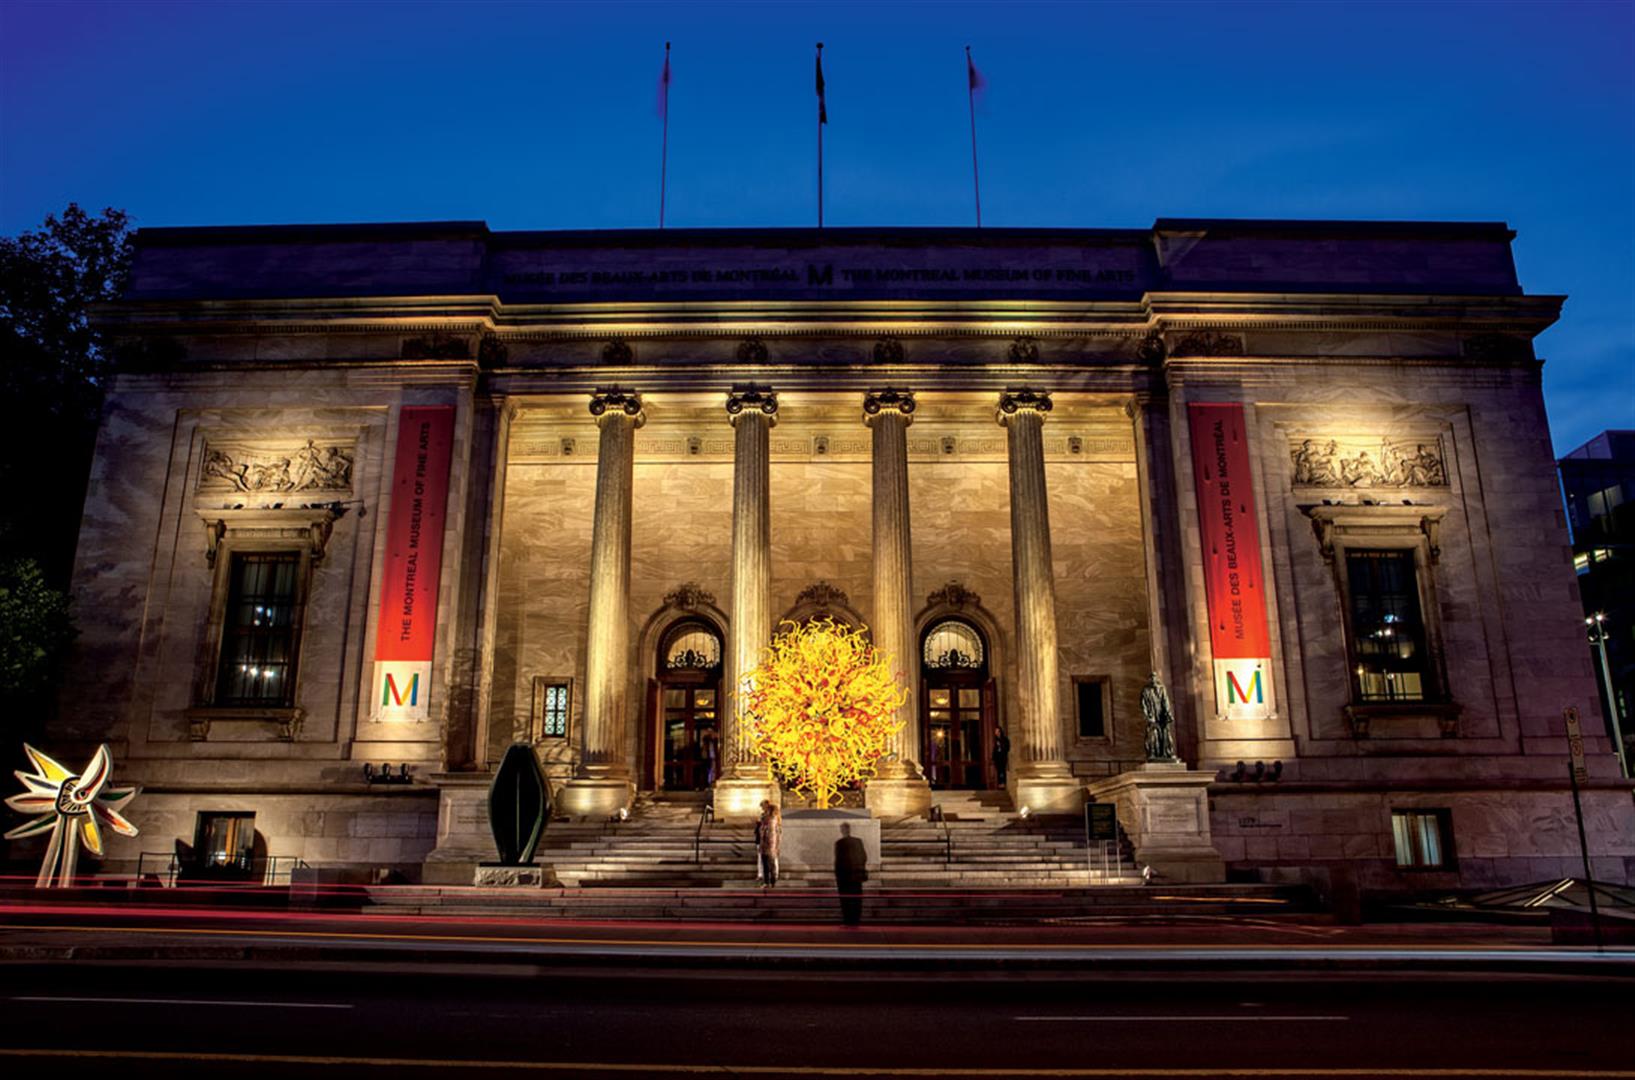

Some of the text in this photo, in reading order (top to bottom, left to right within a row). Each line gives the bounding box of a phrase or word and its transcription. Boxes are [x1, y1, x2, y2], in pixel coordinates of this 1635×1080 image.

[560, 272, 588, 284] DES
[692, 270, 711, 282] DE
[808, 264, 832, 285] M
[840, 269, 873, 281] THE
[876, 269, 960, 281] MONTREAL
[964, 269, 1029, 281] MUSEUM
[1032, 269, 1052, 281] OF
[1056, 269, 1091, 281] FINE
[1096, 269, 1136, 281] ARTS
[401, 421, 431, 642] THE MONTREAL MUSEUM OF FINE ARTS
[1213, 419, 1244, 640] MUSÉE DES BEAUX-ARTS DE MONTRÉAL
